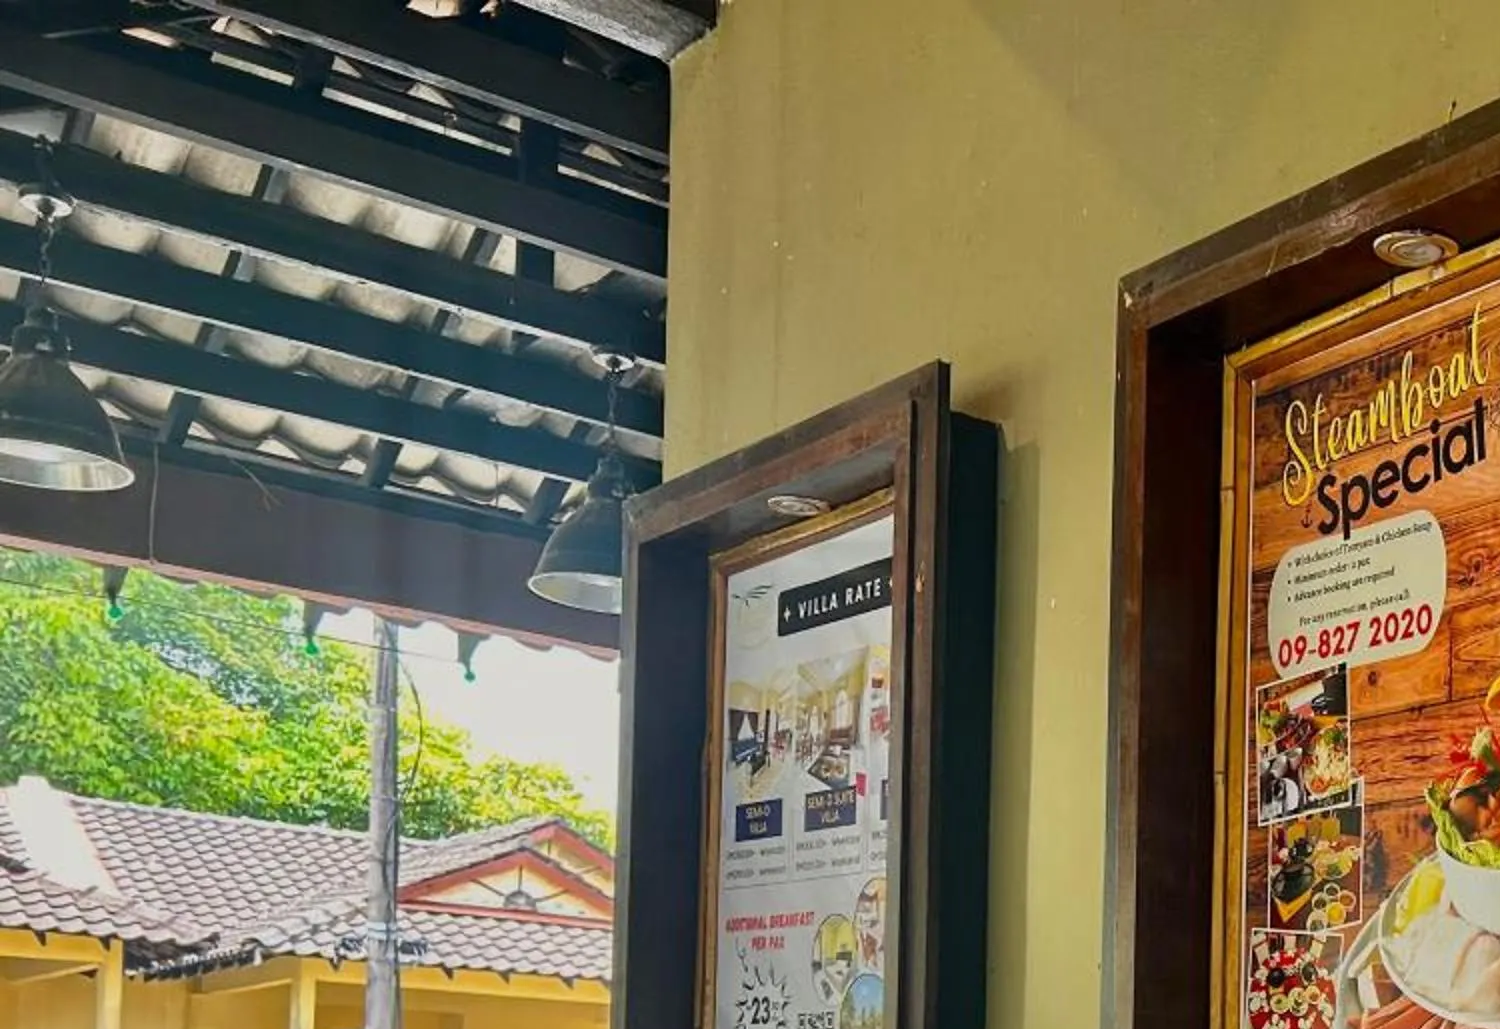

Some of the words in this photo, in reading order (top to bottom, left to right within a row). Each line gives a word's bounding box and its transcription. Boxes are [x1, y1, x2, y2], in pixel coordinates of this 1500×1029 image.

[1283, 301, 1490, 506] Steamboat
[1317, 396, 1487, 540] Special
[798, 592, 838, 619] VILLA
[845, 578, 881, 605] RATE
[1278, 621, 1360, 667] 09-827
[1369, 604, 1433, 648] 2020
[751, 996, 771, 1024] 23
